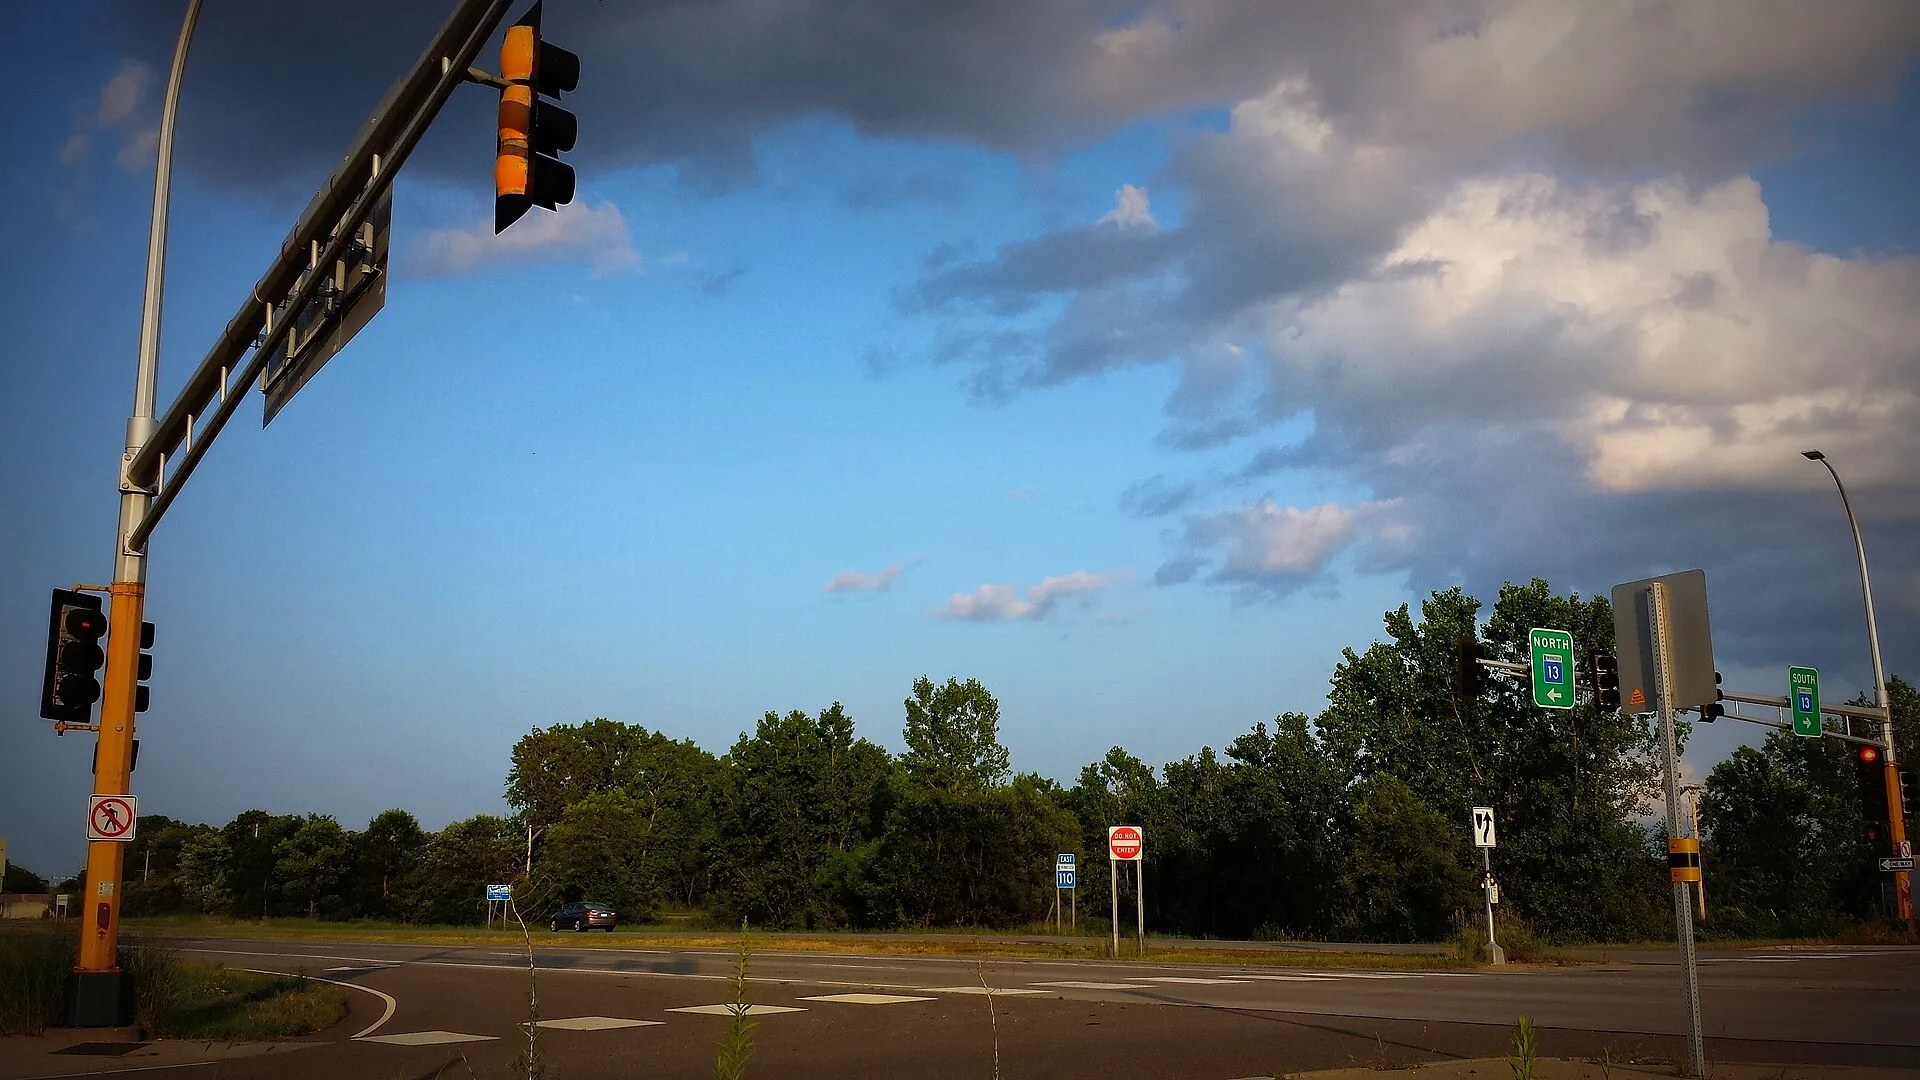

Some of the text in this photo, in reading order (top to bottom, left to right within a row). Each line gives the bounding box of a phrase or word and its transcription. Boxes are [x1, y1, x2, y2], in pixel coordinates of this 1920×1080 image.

[1534, 637, 1569, 649] NORTH
[1548, 665, 1559, 679] 13
[1793, 673, 1815, 684] SOUTH
[1801, 697, 1810, 708] 13
[1059, 872, 1073, 884] 110
